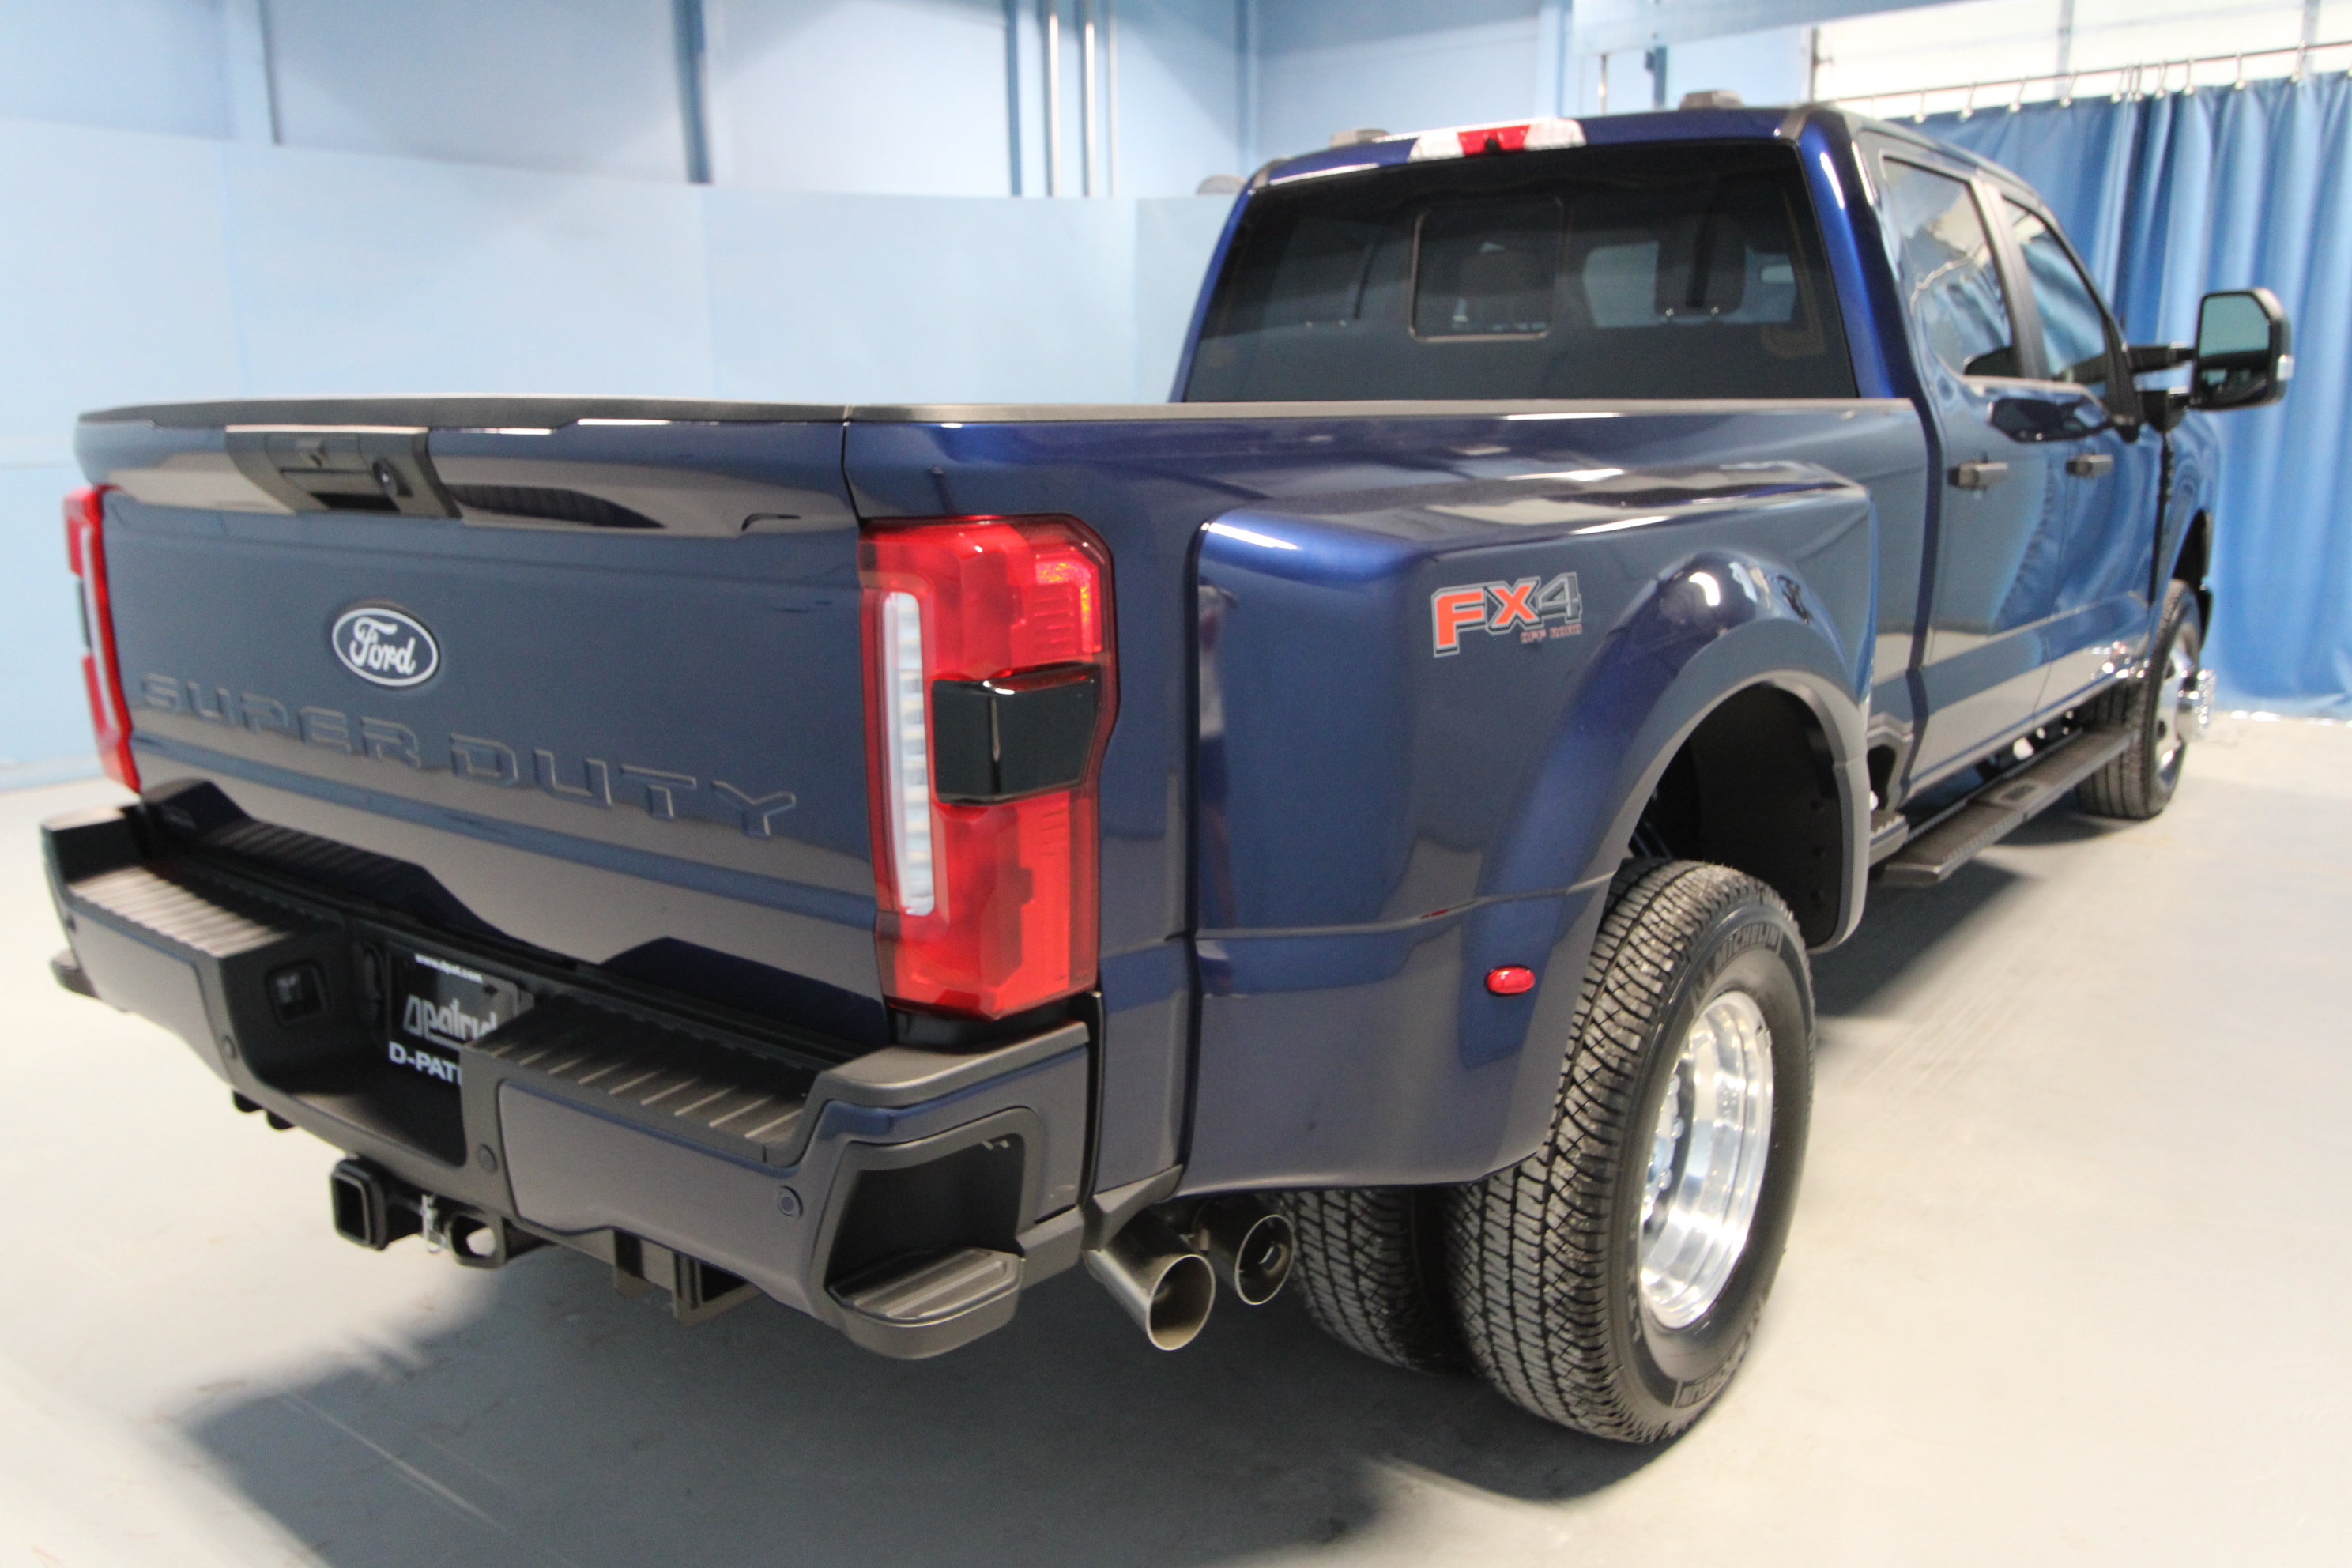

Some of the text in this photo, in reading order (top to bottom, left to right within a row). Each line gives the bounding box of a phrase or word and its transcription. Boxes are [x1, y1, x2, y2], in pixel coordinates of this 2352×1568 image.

[349, 616, 417, 675] Ford
[1431, 571, 1583, 658] FX4
[143, 672, 797, 838] SUPER DUTY
